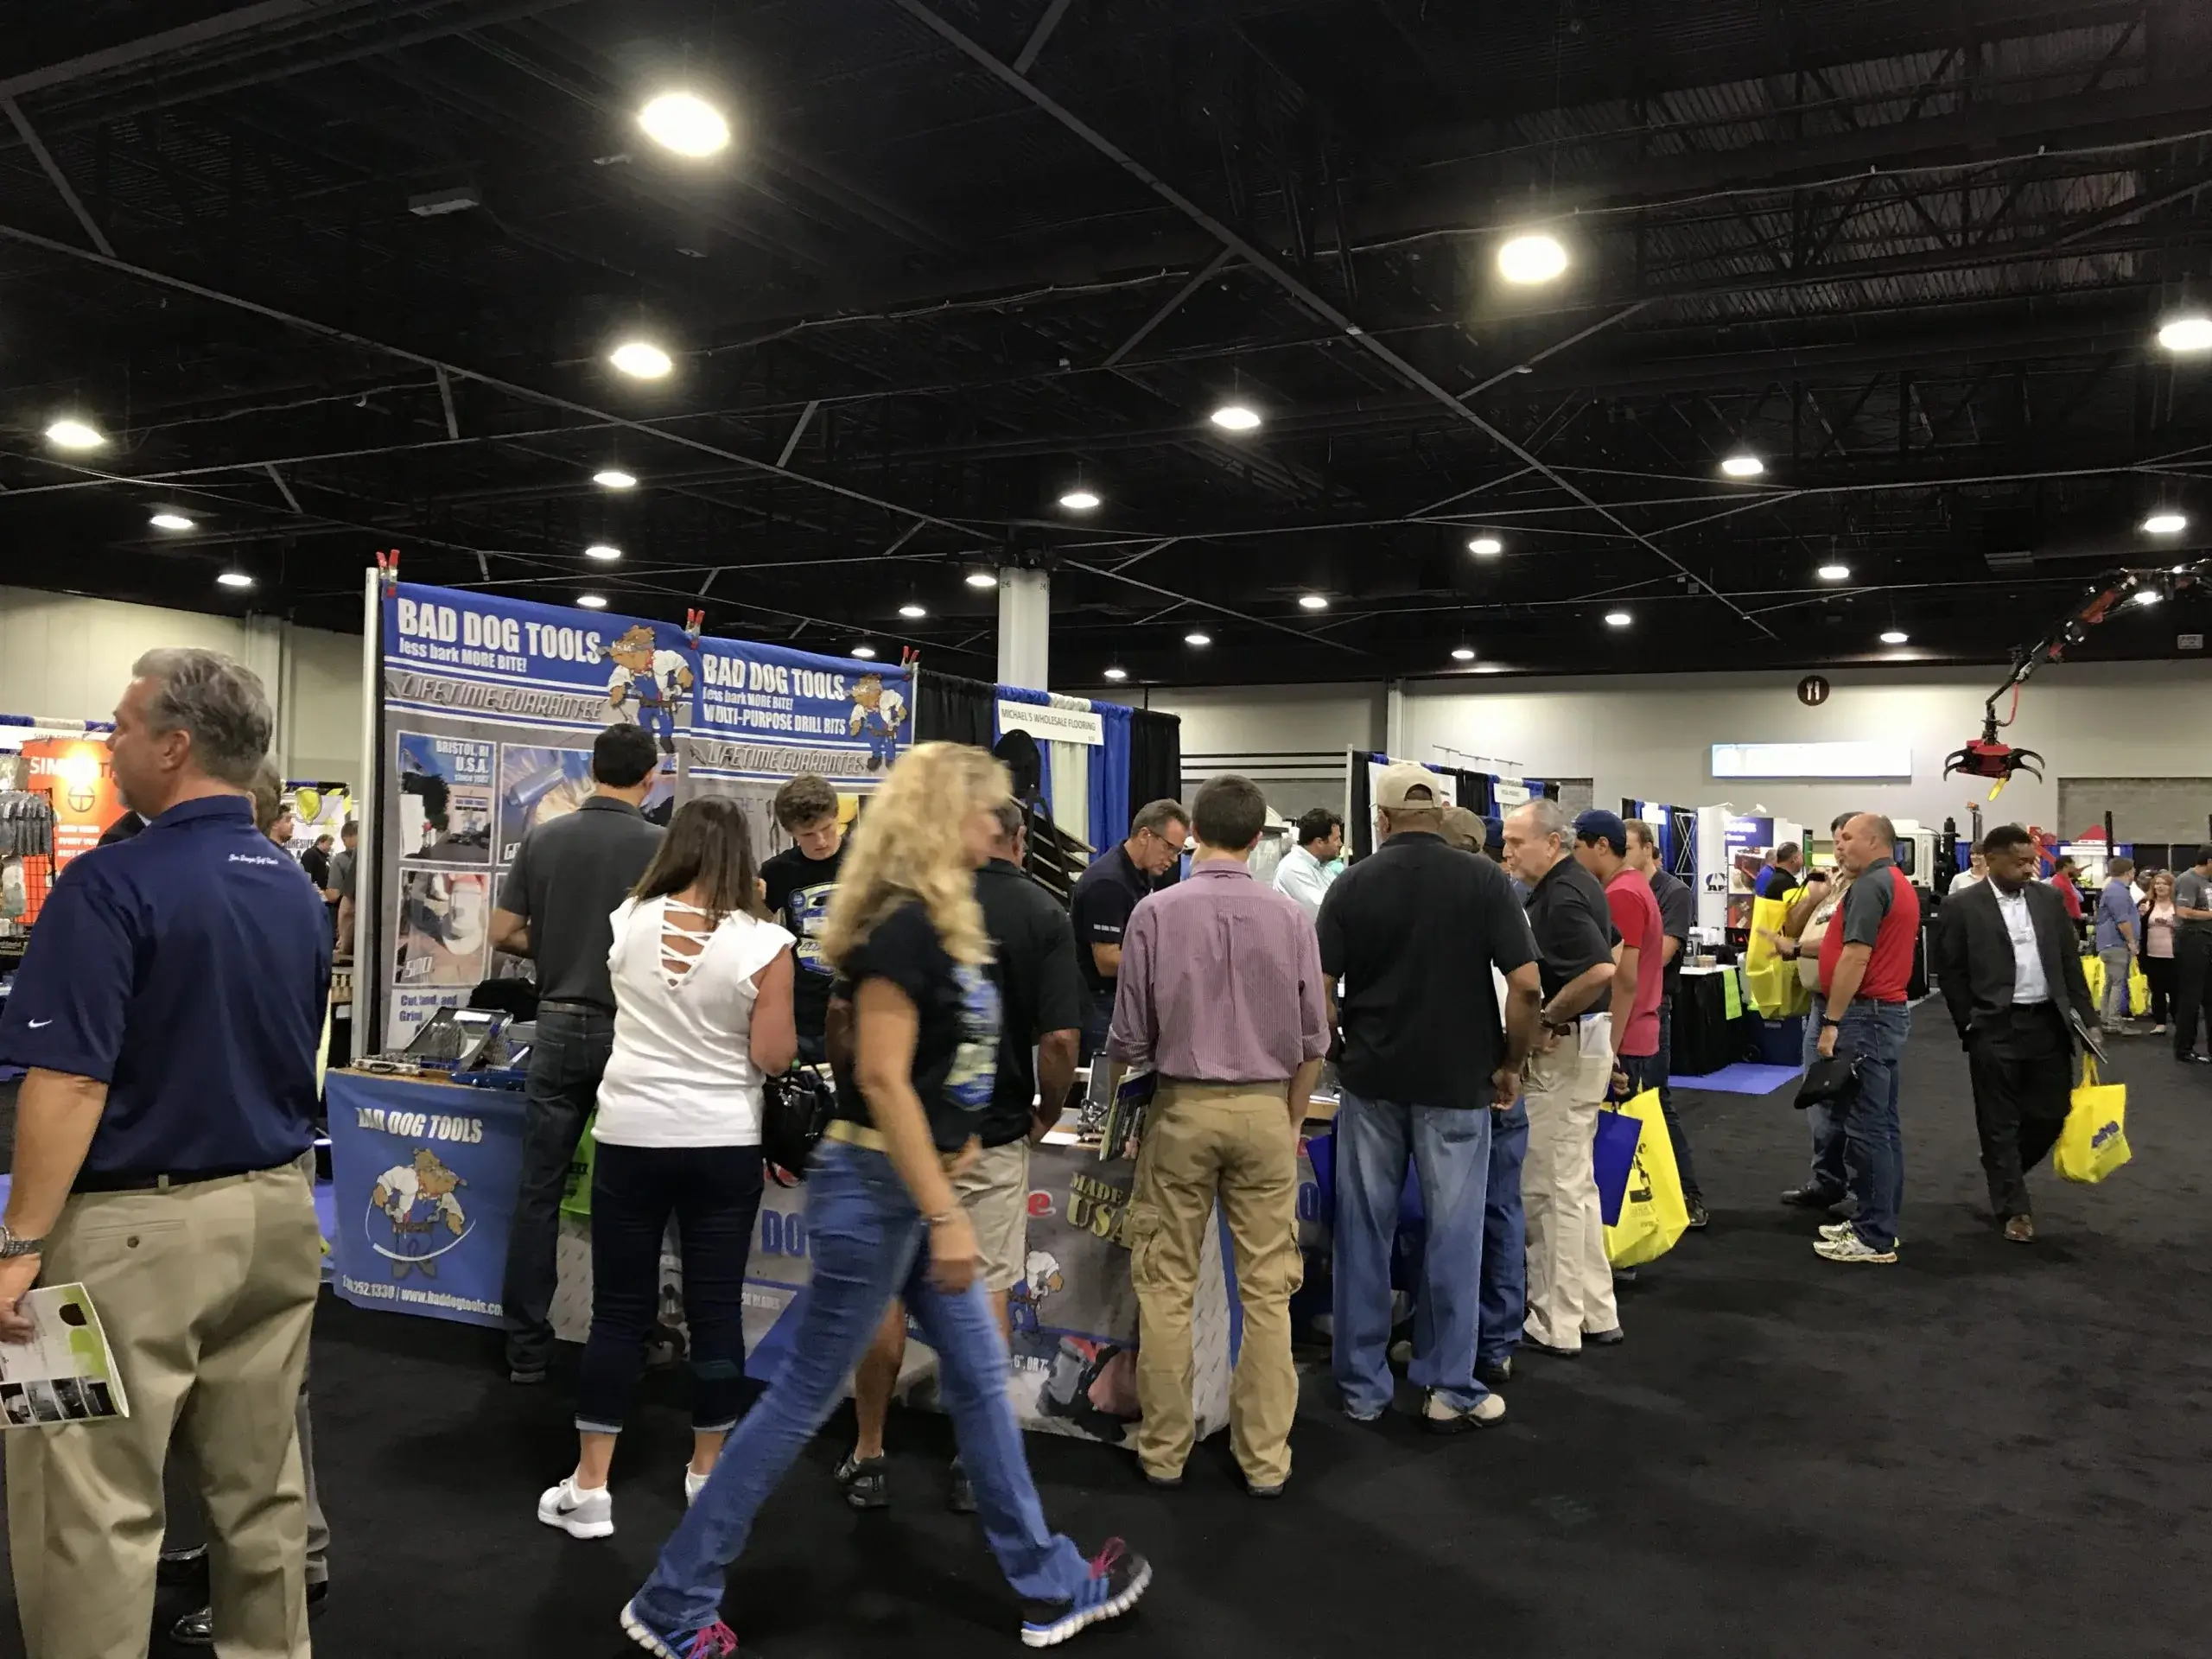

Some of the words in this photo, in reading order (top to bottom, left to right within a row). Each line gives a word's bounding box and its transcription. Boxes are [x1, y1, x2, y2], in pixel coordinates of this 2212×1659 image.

[397, 597, 457, 643] BAD
[463, 610, 519, 653] DOG
[524, 621, 601, 664] TOOLS
[399, 638, 427, 657] less
[429, 644, 459, 664] bark
[461, 648, 495, 669] MORE
[497, 654, 527, 673] BITE!
[702, 653, 746, 689] BAD
[749, 662, 789, 695] DOG
[791, 668, 845, 701] TOOLS
[400, 673, 499, 707] LIFETIME
[499, 690, 608, 720] GUARANTEE
[702, 686, 723, 702] less
[724, 690, 747, 705] bark
[747, 693, 772, 709] MORE
[703, 703, 792, 732] MULTI-PURPOSE
[794, 715, 822, 734] DRILL
[823, 718, 845, 735] BITS
[1001, 708, 1033, 722] MICHAEL'S
[1033, 715, 1067, 728] WHOLESALE
[1068, 718, 1096, 732] FLOORING
[708, 742, 779, 769] LIFETIME
[780, 749, 864, 774] GUARANTEE
[387, 1111, 426, 1138] DOG
[428, 1114, 483, 1144] TOOLS
[401, 1287, 504, 1317] www.baddogtools.co
